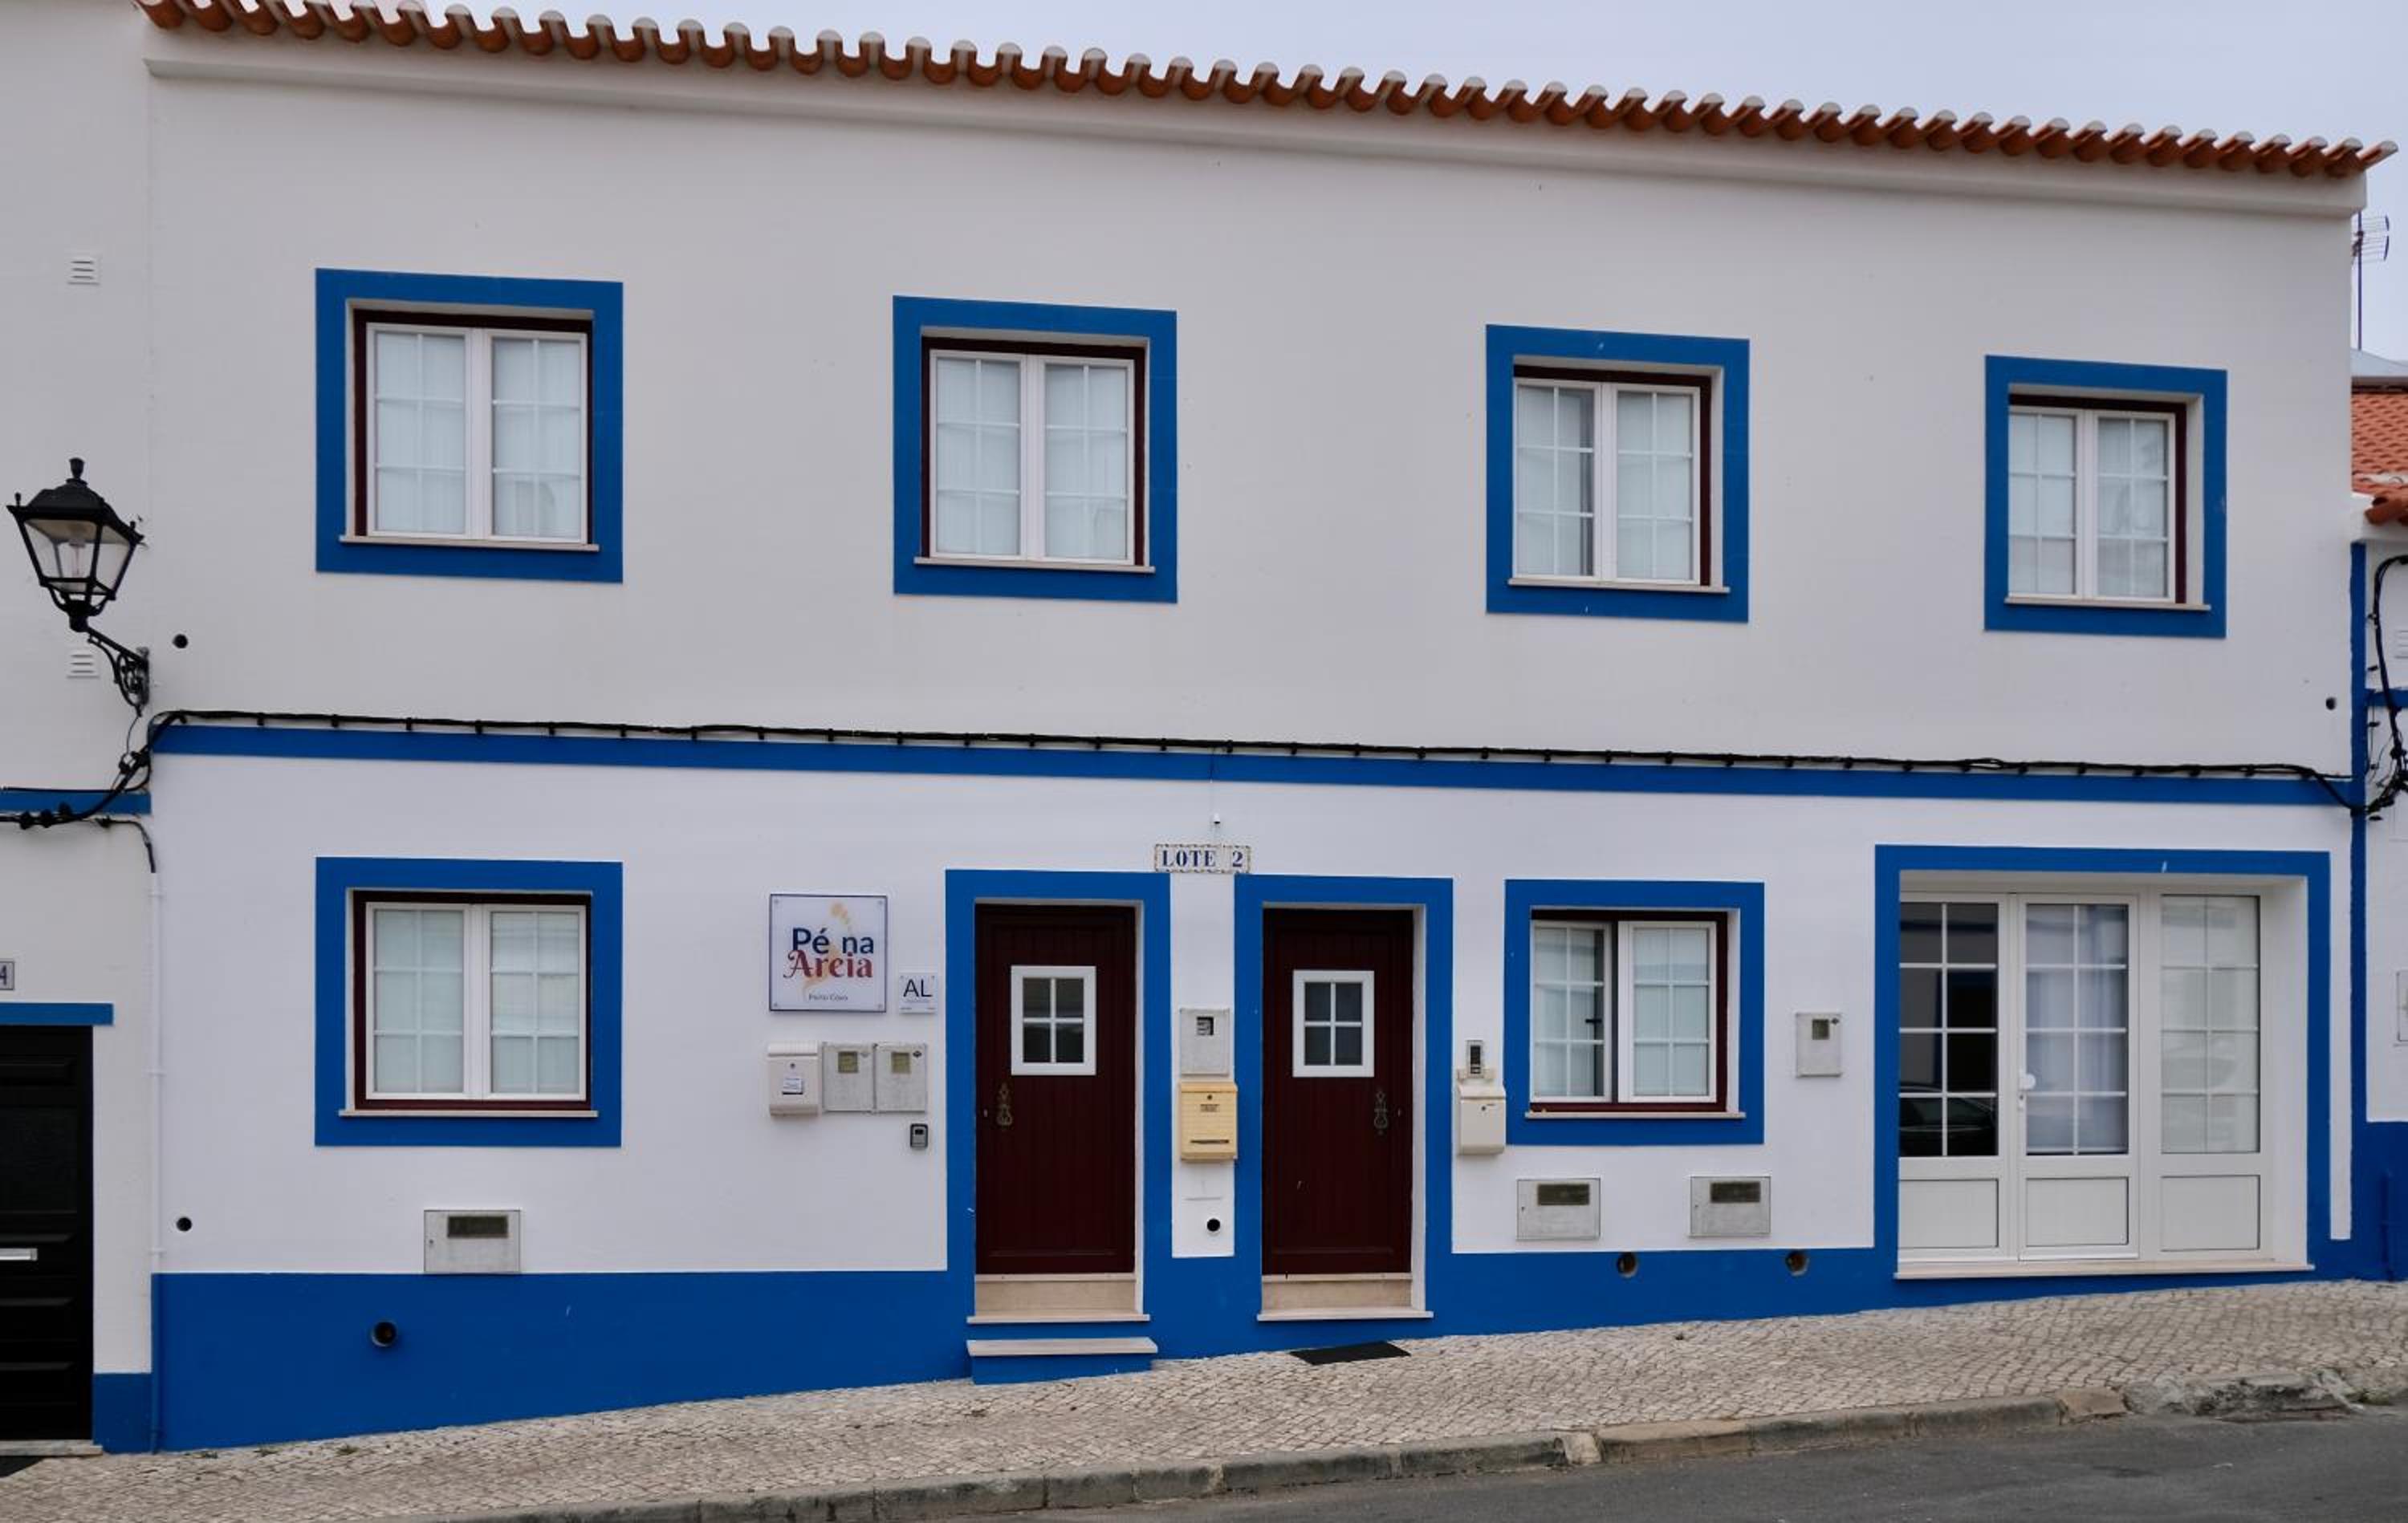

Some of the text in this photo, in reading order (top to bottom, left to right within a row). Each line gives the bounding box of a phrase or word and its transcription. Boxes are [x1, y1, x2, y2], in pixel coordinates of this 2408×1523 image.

[1161, 850, 1243, 867] LOTE 2
[792, 927, 874, 954] Pé na
[783, 948, 873, 978] Areia
[903, 978, 934, 997] AL
